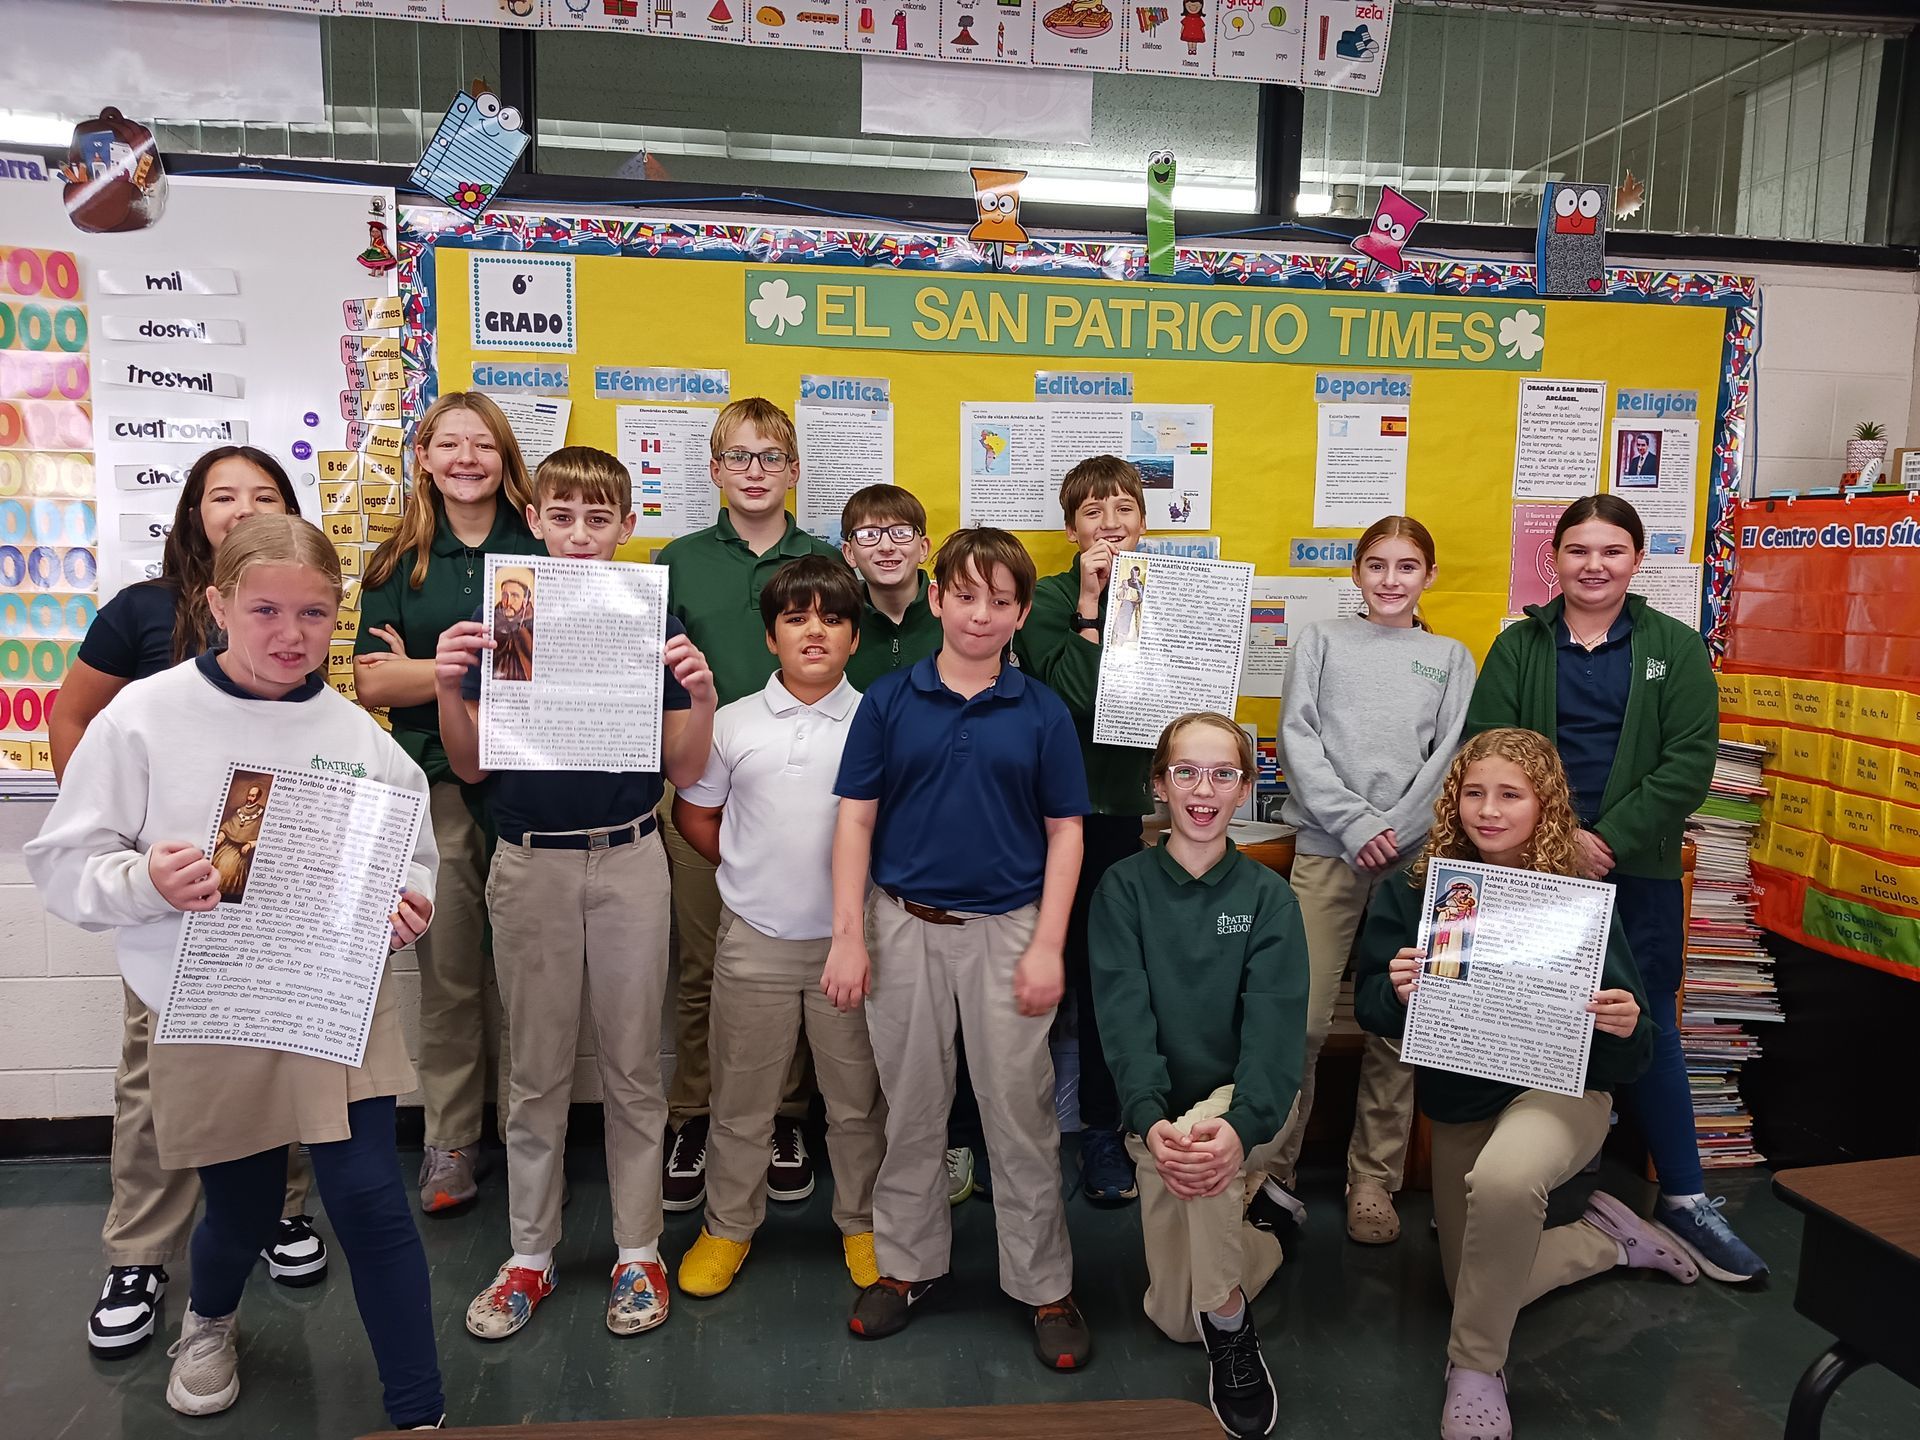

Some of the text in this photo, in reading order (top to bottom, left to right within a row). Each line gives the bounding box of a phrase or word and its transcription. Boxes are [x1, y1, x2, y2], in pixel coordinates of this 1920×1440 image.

[571, 13, 584, 21] reloj
[1355, 4, 1383, 21] zeta
[612, 17, 629, 25] regalo
[146, 271, 182, 291] mil
[347, 304, 362, 315] Hoy
[485, 311, 563, 334] GRADO
[816, 285, 1496, 362] EL SAN PATRICIO TIMES
[139, 321, 206, 339] dosmil
[345, 341, 360, 351] Hoy
[350, 367, 365, 378] Hoy
[373, 371, 399, 381] Lunes
[127, 364, 213, 393] tresmil
[344, 394, 359, 405] Hoy
[1617, 393, 1697, 418] Religión
[115, 420, 232, 441] cuatromil
[351, 427, 366, 438] Hoy
[371, 436, 400, 448] Martes
[328, 462, 348, 471] 8 de
[385, 465, 396, 475] de
[327, 494, 351, 503] 15 de
[365, 496, 396, 507] agosto
[333, 525, 353, 534] 6 de
[1741, 527, 1757, 547] El
[1762, 527, 1816, 547] Centro
[1821, 525, 1850, 546] de
[1856, 525, 1886, 547] las
[1297, 543, 1358, 561] Social
[341, 556, 352, 566] de
[332, 656, 344, 665] 23
[337, 683, 346, 693] 12
[1881, 710, 1888, 718] fu
[10, 751, 22, 761] de
[38, 752, 49, 762] 14
[1898, 766, 1912, 776] ma,
[276, 775, 297, 785] Santo
[300, 779, 324, 789] Toribio
[1905, 780, 1919, 791] mo,
[1793, 806, 1803, 814] pu
[1844, 808, 1875, 822] ra, re, ri,
[279, 822, 319, 834] Santo Toribio
[1849, 821, 1868, 832] ro, ru
[1889, 822, 1904, 833] rre,
[1874, 870, 1897, 886] Los
[1486, 875, 1508, 884] SANTA
[1510, 879, 1529, 887] ROSA
[1541, 884, 1560, 893] LIMA.
[1422, 974, 1444, 982] Nombre
[1421, 980, 1450, 989] MILAGROS
[1532, 984, 1567, 994] canonizado
[1416, 1017, 1433, 1025] Cada
[1450, 1023, 1470, 1032] agosto
[1414, 1029, 1430, 1037] Santa
